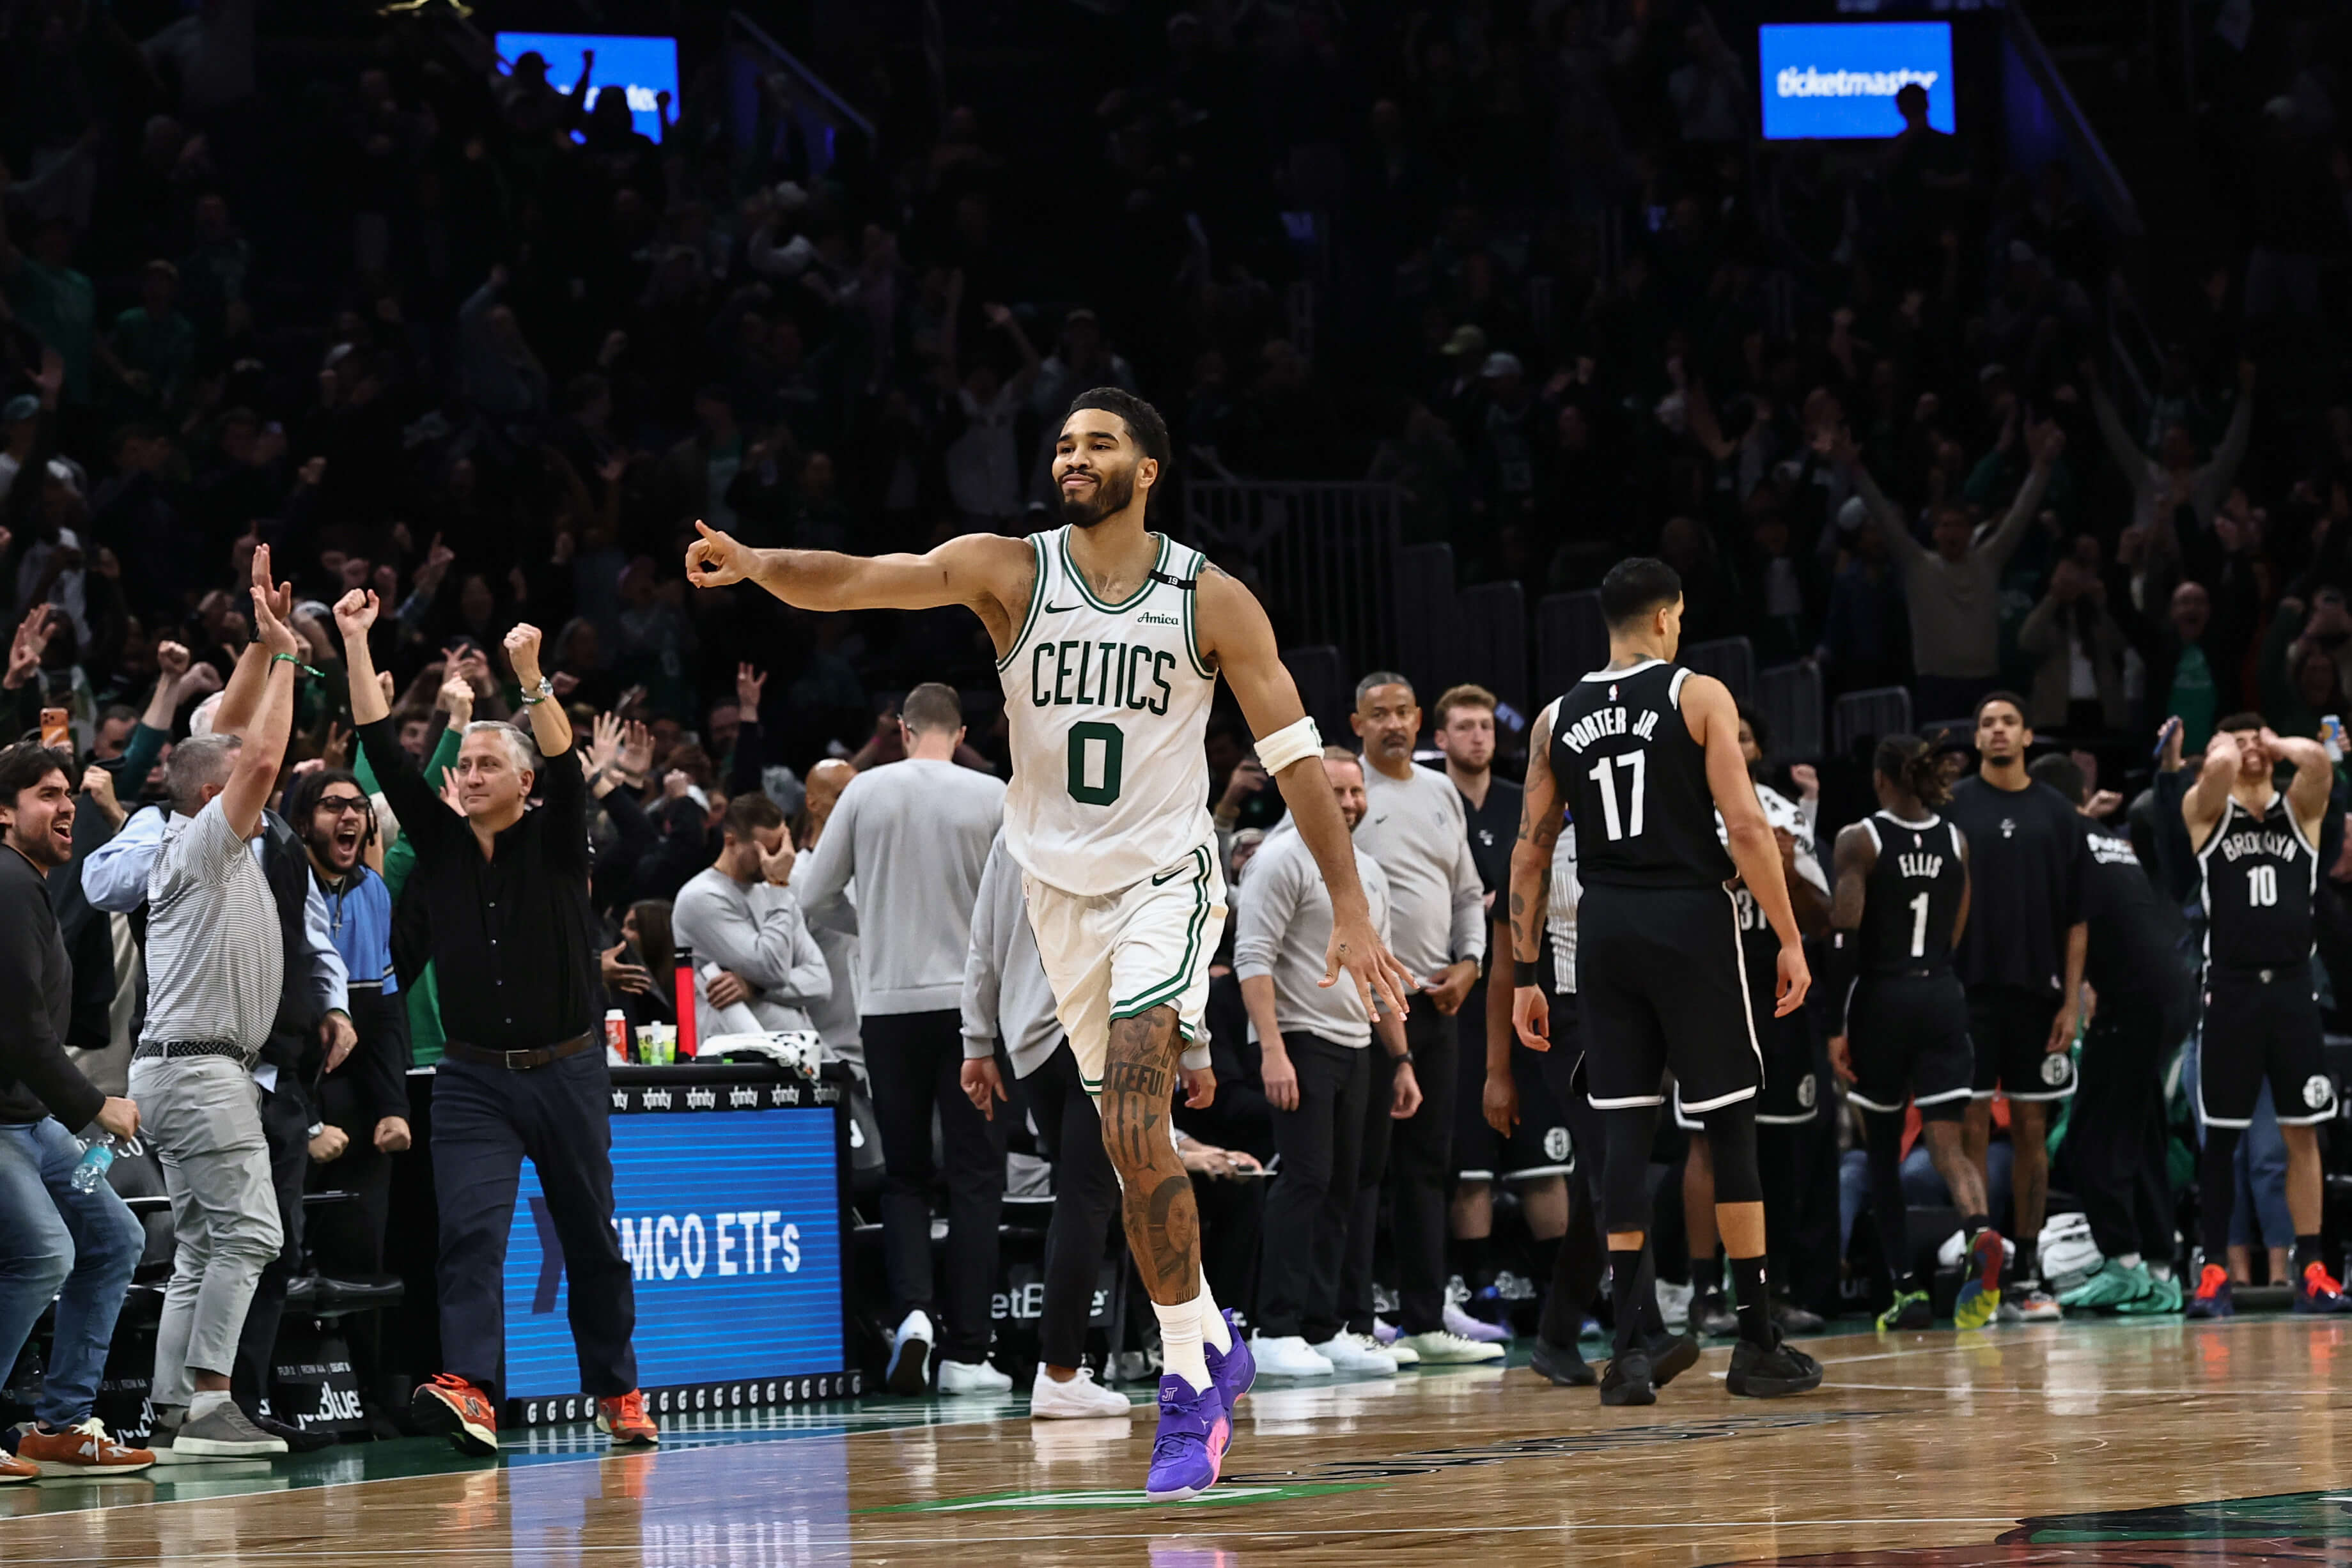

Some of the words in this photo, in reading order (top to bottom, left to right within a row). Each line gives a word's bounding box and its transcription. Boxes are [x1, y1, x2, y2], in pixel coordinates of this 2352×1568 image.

[1167, 577, 1178, 585] 19
[1137, 612, 1179, 625] Amica
[1032, 640, 1176, 716] CELTICS
[1562, 706, 1626, 754] PORTER
[1632, 709, 1659, 741] JR.
[1068, 721, 1124, 806] 0
[1589, 749, 1645, 841] 17
[1898, 852, 1943, 878] ELLIS
[2247, 865, 2277, 907] 10
[1910, 892, 1929, 957] 1
[642, 1087, 672, 1110] xfinity
[685, 1086, 716, 1109] xfinity
[729, 1085, 758, 1108] xfinity
[771, 1083, 800, 1106] xfinity
[716, 1211, 800, 1276] ETFs
[991, 1283, 1105, 1319] etBe
[297, 1381, 364, 1431] Blue
[527, 1402, 537, 1424] G
[547, 1401, 556, 1422] G
[566, 1399, 575, 1419] G
[585, 1397, 595, 1418] G
[660, 1392, 669, 1411] G
[678, 1390, 687, 1410] G
[696, 1388, 705, 1409] G
[713, 1387, 723, 1408] G
[731, 1386, 741, 1406] G
[749, 1384, 759, 1404] G
[767, 1383, 776, 1402] G
[784, 1381, 793, 1401] G
[801, 1379, 811, 1399] G
[818, 1378, 827, 1397] G
[852, 1375, 861, 1395] G
[1162, 1386, 1178, 1401] JT
